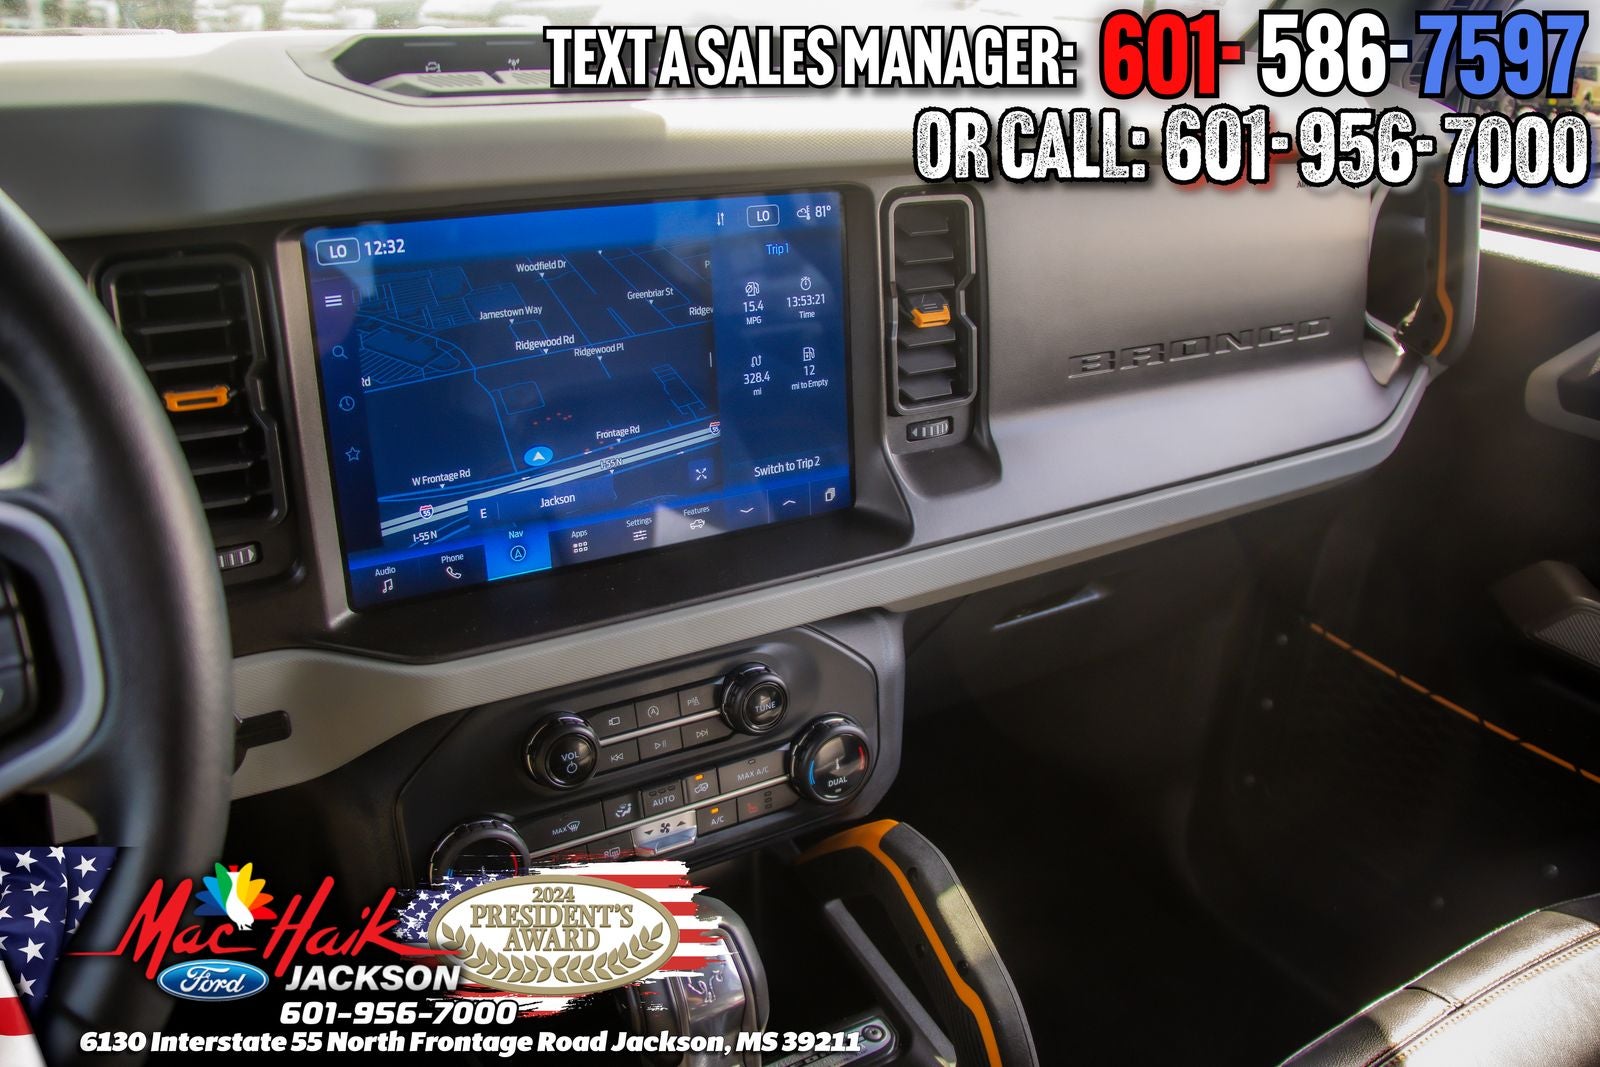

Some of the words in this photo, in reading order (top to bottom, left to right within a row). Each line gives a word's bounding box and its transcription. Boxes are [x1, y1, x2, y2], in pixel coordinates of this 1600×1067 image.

[756, 211, 770, 222] LO
[815, 205, 831, 218] 81°
[329, 245, 347, 259] LO
[364, 239, 405, 256] 12:32
[766, 243, 784, 256] Trip
[515, 261, 556, 272] Woodfield
[557, 260, 566, 270] Dr
[627, 288, 663, 300] Greenbriar
[665, 287, 674, 296] St
[743, 301, 764, 313] 15.4
[786, 294, 825, 308] 13:53:21
[479, 307, 523, 320] Jamestown
[525, 305, 542, 319] Way
[799, 310, 815, 320] Time
[746, 317, 762, 326] MPG
[515, 336, 560, 351] Ridgewood
[562, 334, 575, 345] Rd
[1068, 317, 1331, 379] BRONCO
[574, 344, 615, 357] Ridgewood
[616, 343, 624, 352] Pl
[804, 366, 815, 376] 12
[743, 371, 771, 385] 328.4
[791, 381, 800, 390] mi
[801, 380, 808, 389] to
[808, 378, 828, 390] Empty
[753, 387, 762, 396] mi
[596, 427, 628, 440] Frontage
[629, 425, 640, 435] Rd
[754, 464, 785, 478] Switch
[786, 462, 795, 472] to
[796, 458, 813, 472] Trip
[814, 456, 821, 467] 2
[412, 477, 421, 486] W
[422, 472, 458, 485] Frontage
[459, 469, 471, 479] Rd
[540, 493, 575, 508] Jackson
[422, 509, 432, 518] 55
[480, 508, 487, 519] E
[683, 506, 710, 517] Features
[626, 516, 652, 528] Settings
[413, 532, 430, 543] I-55
[430, 530, 437, 540] N
[508, 530, 523, 539] Nav
[571, 528, 587, 540] Apps
[441, 552, 464, 564] Phone
[375, 566, 396, 577] Audio
[754, 701, 776, 713] TUNE
[561, 751, 580, 762] VOL
[737, 771, 754, 782] MAX
[756, 766, 769, 776] A/C
[828, 776, 847, 787] DUAL
[652, 795, 676, 808] AUTO
[711, 815, 725, 826] A/C
[552, 826, 568, 836] MAX
